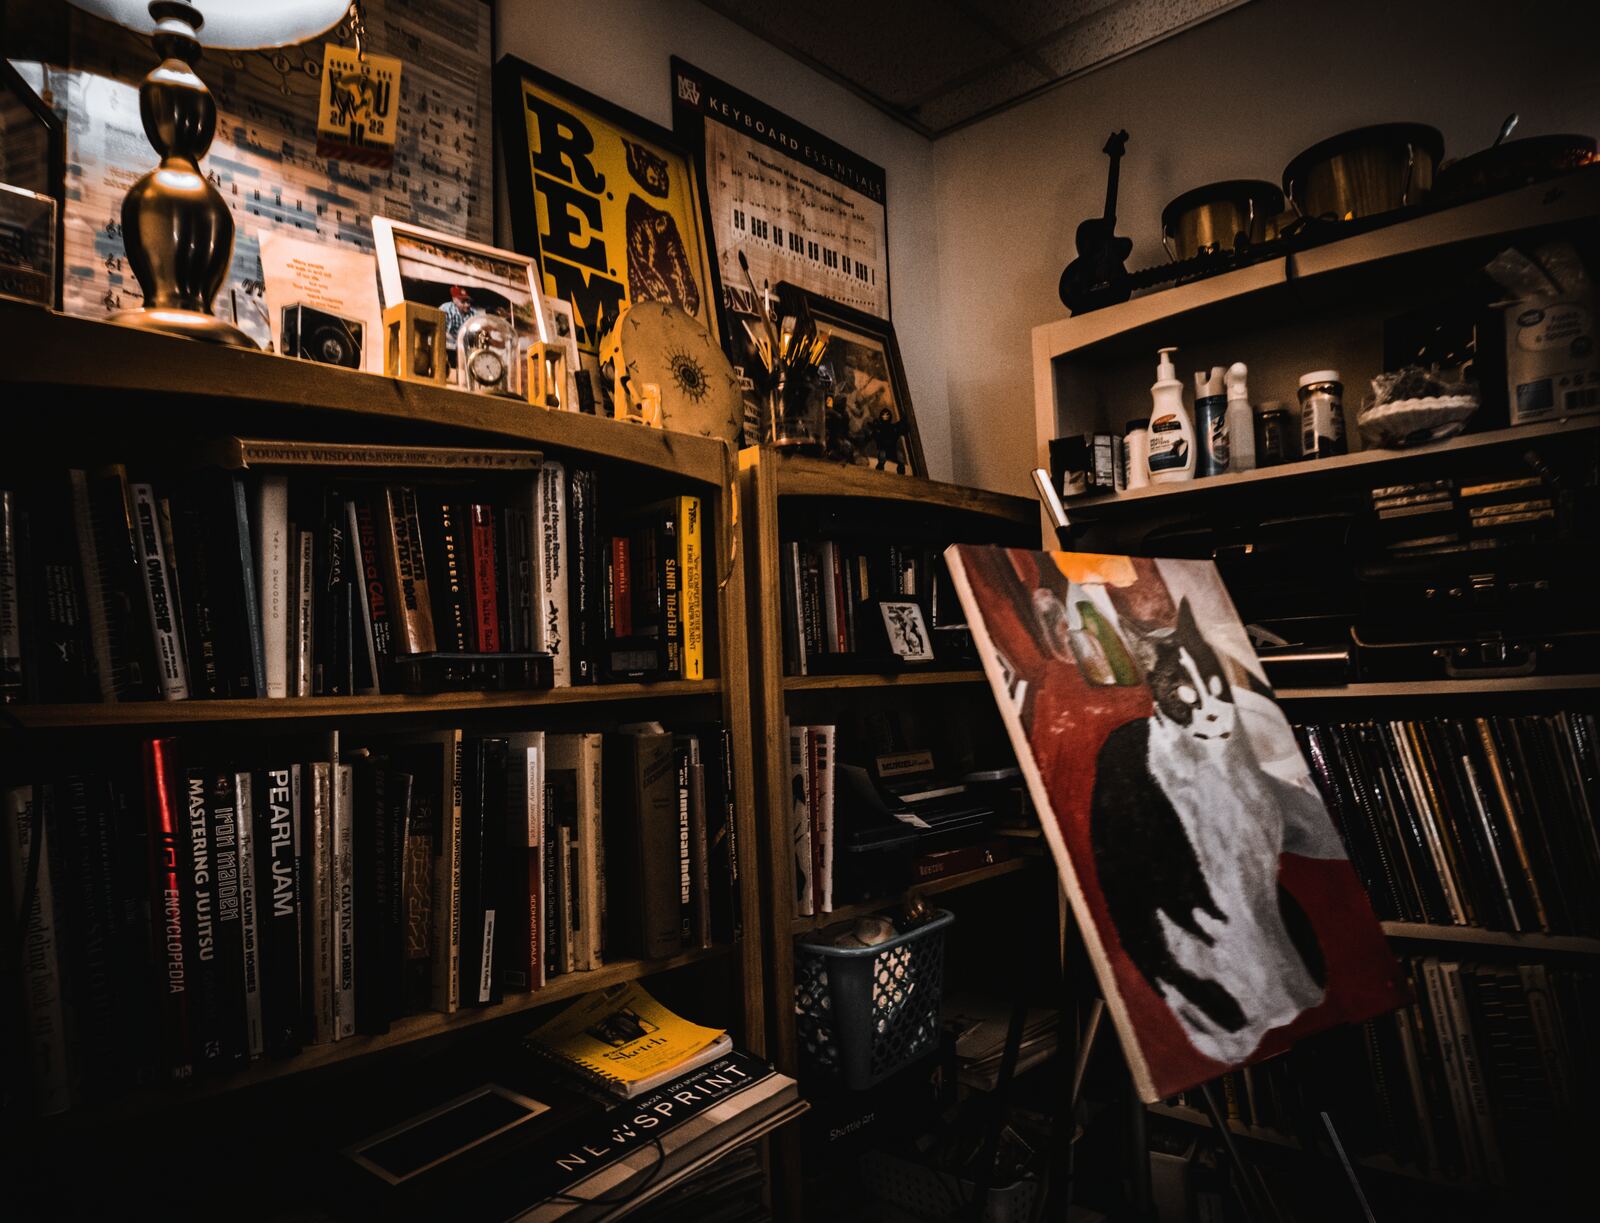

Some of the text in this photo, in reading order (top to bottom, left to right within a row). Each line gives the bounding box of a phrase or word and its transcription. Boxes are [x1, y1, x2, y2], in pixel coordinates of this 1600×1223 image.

[709, 97, 883, 199] KEYBOARD ESSENTIALS
[247, 448, 308, 460] COUNTRY
[312, 449, 367, 462] WISDOM
[542, 468, 553, 522] Remodeling
[550, 470, 560, 503] Manual
[552, 514, 560, 542] Home
[331, 528, 344, 586] Nirvana
[545, 534, 554, 593] Maintenance
[552, 542, 561, 580] Repairs,
[663, 559, 676, 590] HINTS
[147, 558, 173, 634] OWNERSHIP
[369, 581, 387, 621] CALL
[693, 572, 701, 606] COMPLETE
[664, 593, 678, 638] HELPFUL
[688, 602, 697, 650] IMPROVEMENT
[694, 609, 702, 633] GUIDE
[453, 740, 464, 807] Remington
[529, 761, 538, 839] Elementary JavaScript
[269, 769, 294, 919] PEARL JAM
[680, 788, 691, 904] American Indian
[189, 779, 215, 961] MASTERING JUJITSU
[243, 889, 256, 926] CALVIN
[341, 885, 352, 930] CALVIN
[452, 889, 460, 946] ILLUSTRATIONS
[163, 888, 184, 994] ENCYCLOPEDIA
[245, 927, 258, 950] AND
[246, 951, 258, 994] HOBBES
[342, 944, 353, 991] HOBBES
[609, 1038, 668, 1060] Sketch
[556, 1065, 747, 1171] NEWSPRINT
[829, 1118, 862, 1142] Shuttle
